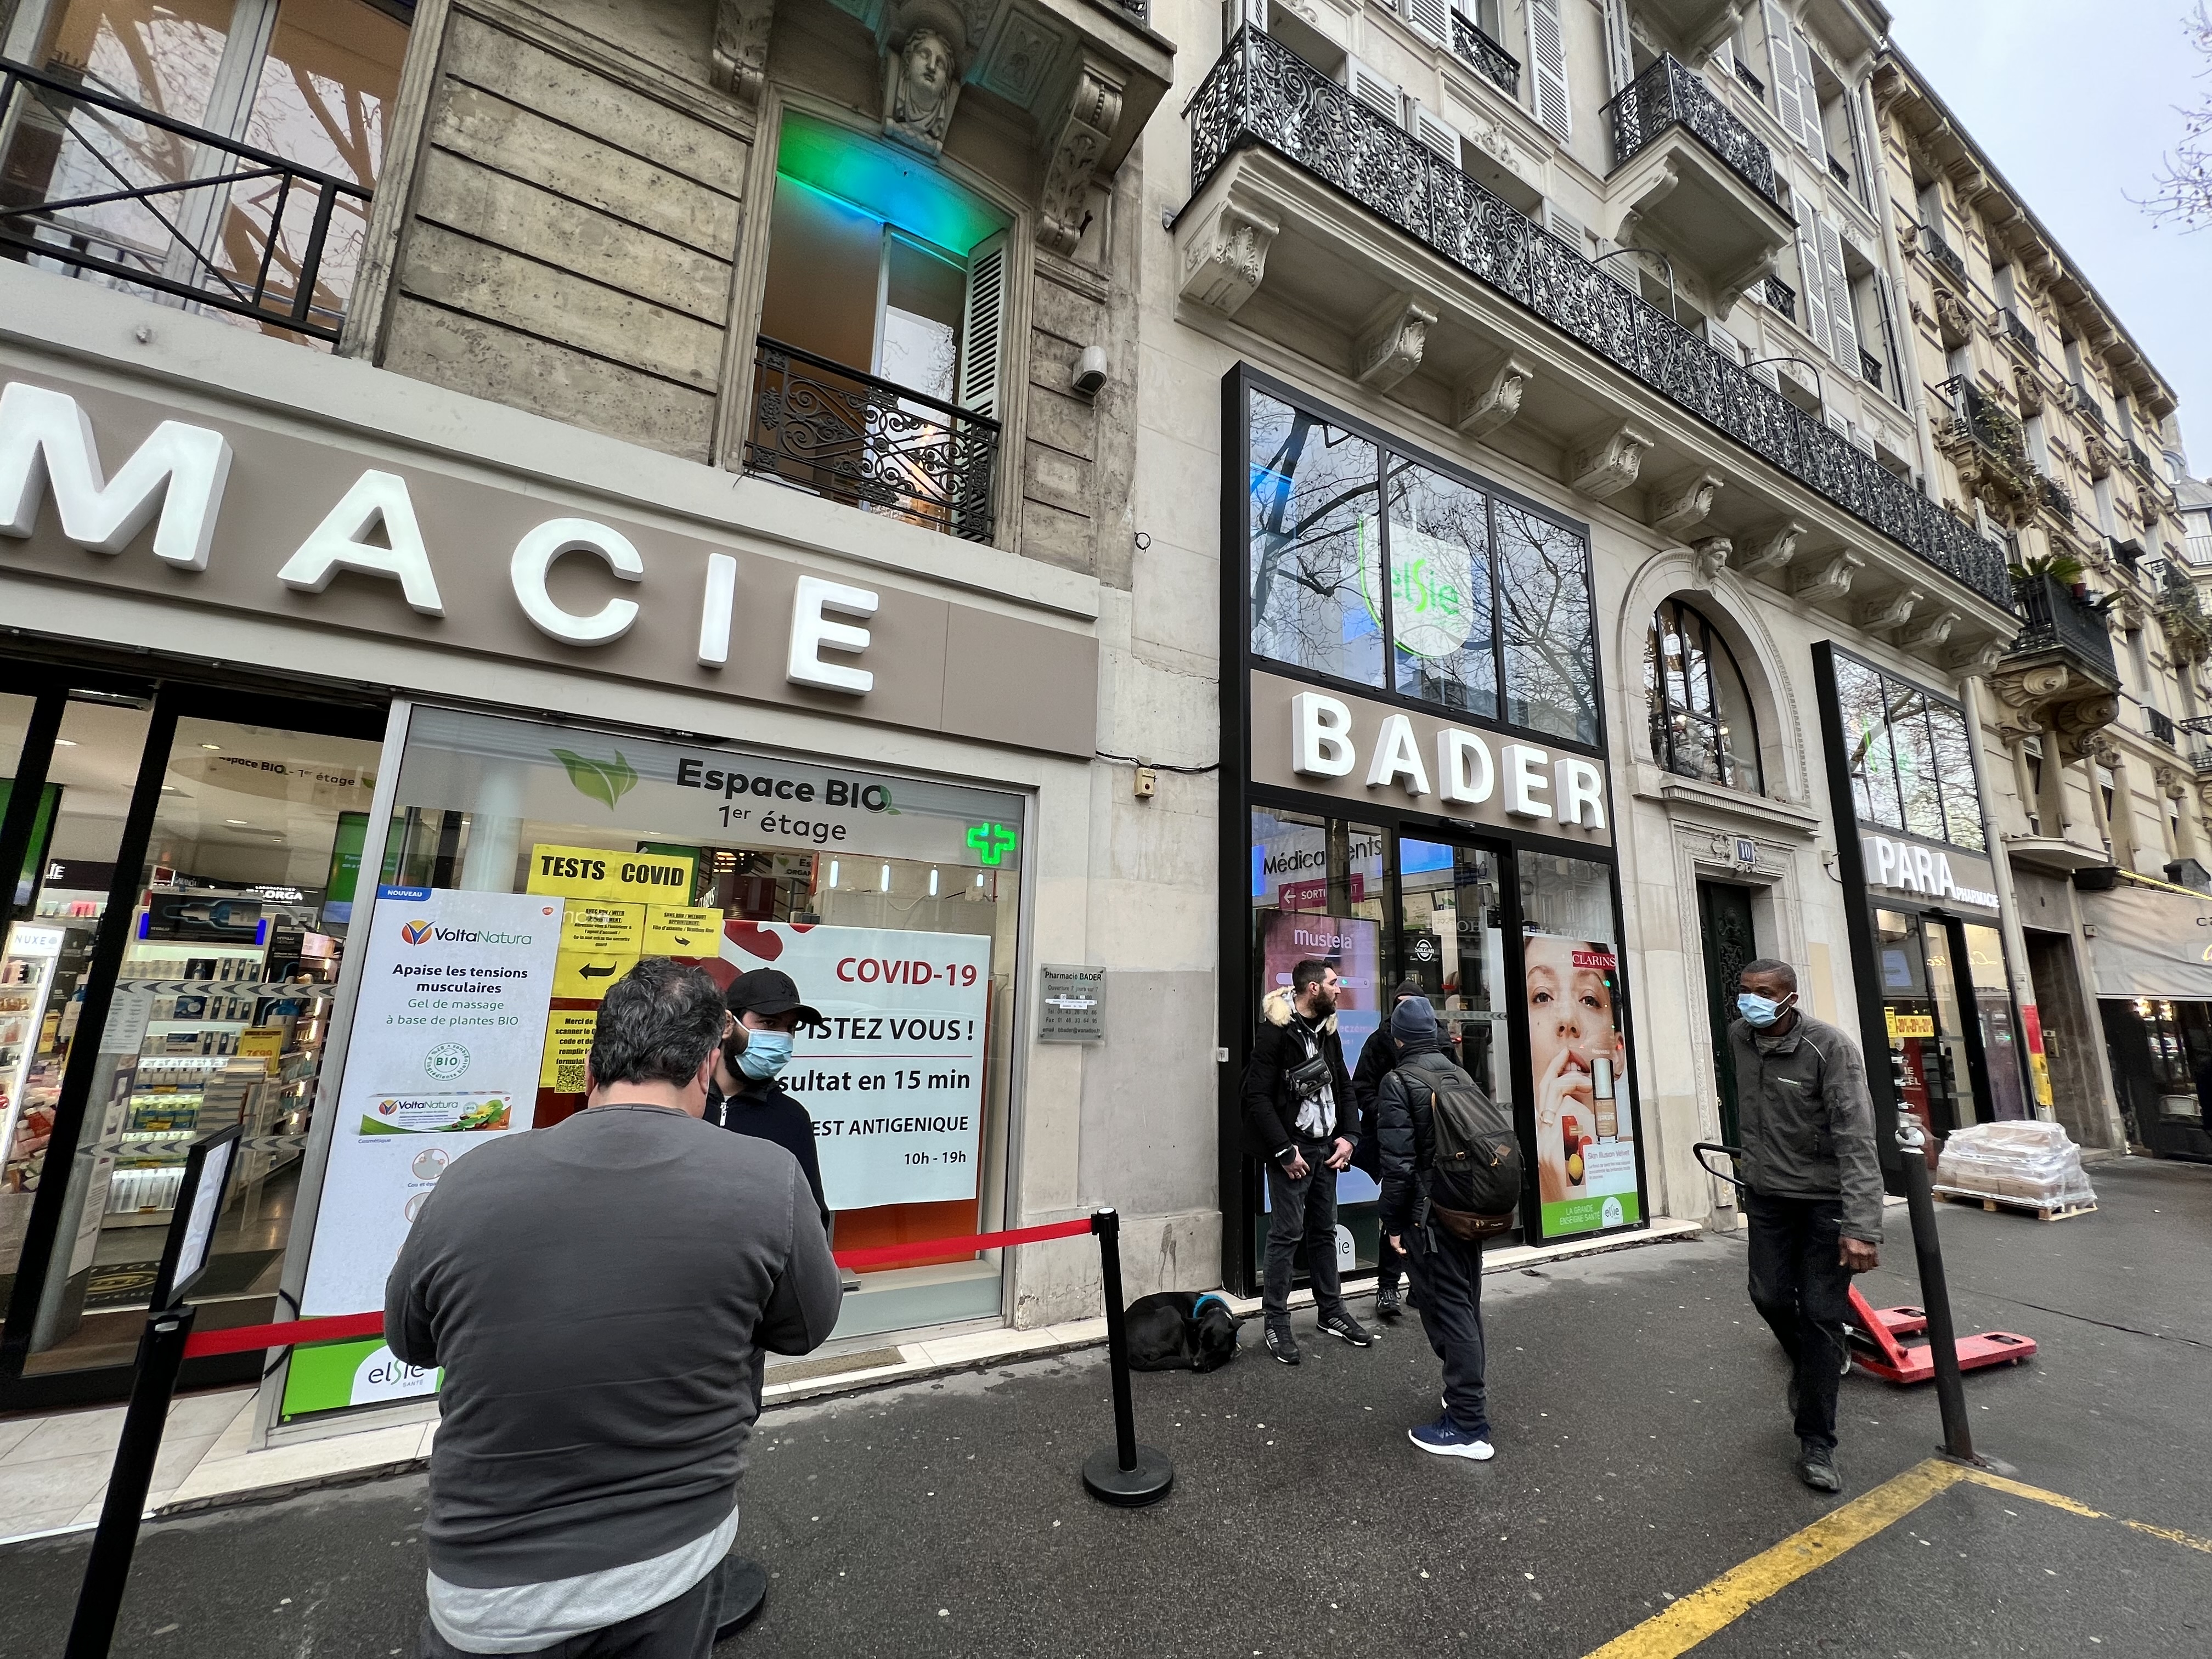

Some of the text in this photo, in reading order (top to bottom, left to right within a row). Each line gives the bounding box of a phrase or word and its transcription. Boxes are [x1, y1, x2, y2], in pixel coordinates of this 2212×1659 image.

[0, 381, 879, 697] MACIE
[1292, 691, 1606, 830] BADER
[261, 761, 285, 775] BIO
[316, 772, 356, 787] étage
[676, 758, 891, 813] Espace BIO
[718, 805, 848, 844] 1er étage
[1263, 836, 1382, 875] Médicaents
[1740, 843, 1750, 859] 10
[541, 855, 685, 887] TESTS COVID
[1863, 836, 2000, 909] PARA PHARMACIE
[14, 934, 47, 945] NUXE
[435, 927, 532, 945] VoltaNatura
[1572, 953, 1616, 967] CLARINS
[393, 964, 528, 978] Apaise les tensions
[836, 957, 977, 986] COVID-19
[1045, 971, 1078, 980] Pharmacie
[416, 983, 501, 994] musculaires
[408, 999, 504, 1011] Gel de massage
[386, 1015, 519, 1027] à base de plantes BIO
[890, 1018, 961, 1040] VOUS
[436, 1057, 458, 1065] BIO
[859, 1073, 885, 1090] en
[894, 1070, 921, 1090] 15
[928, 1070, 970, 1089] min
[399, 1101, 459, 1109] VoltaNatura
[848, 1116, 969, 1136] ANTIGENIQUE
[905, 1152, 930, 1164] 10h
[942, 1150, 967, 1163] 19h
[1560, 1210, 1601, 1225] ENSEIGNE SANTÉ
[1573, 1204, 1594, 1215] GRANDE
[368, 1359, 425, 1385] elsie
